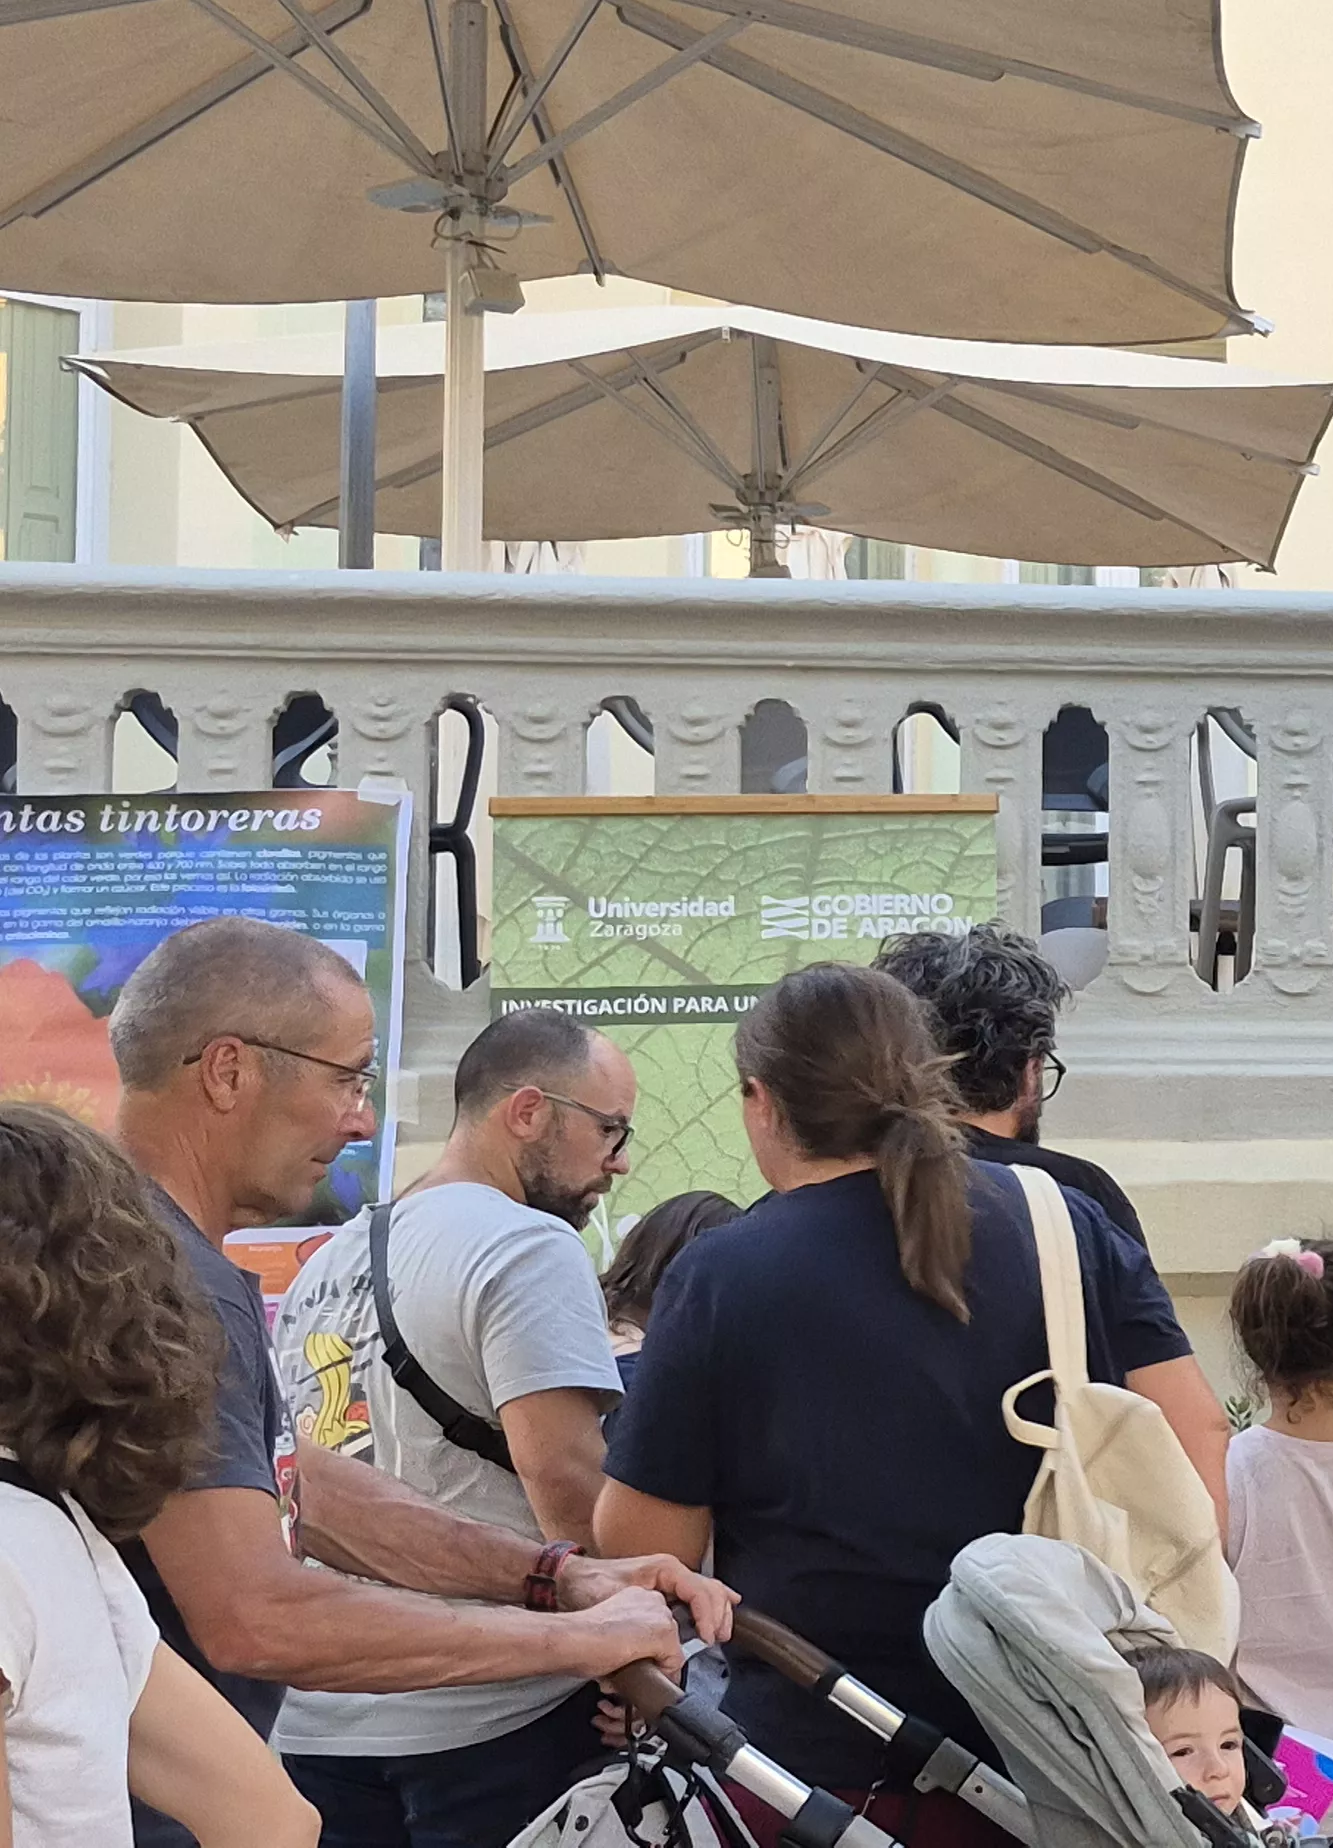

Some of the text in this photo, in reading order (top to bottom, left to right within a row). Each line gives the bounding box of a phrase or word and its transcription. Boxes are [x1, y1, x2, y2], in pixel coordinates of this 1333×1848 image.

[100, 800, 323, 834] tintoreras
[587, 894, 736, 918] Universidad
[811, 894, 954, 917] GOBIERNO
[589, 920, 683, 940] Zaragoza
[812, 918, 848, 939] DE
[672, 994, 730, 1013] PARA
